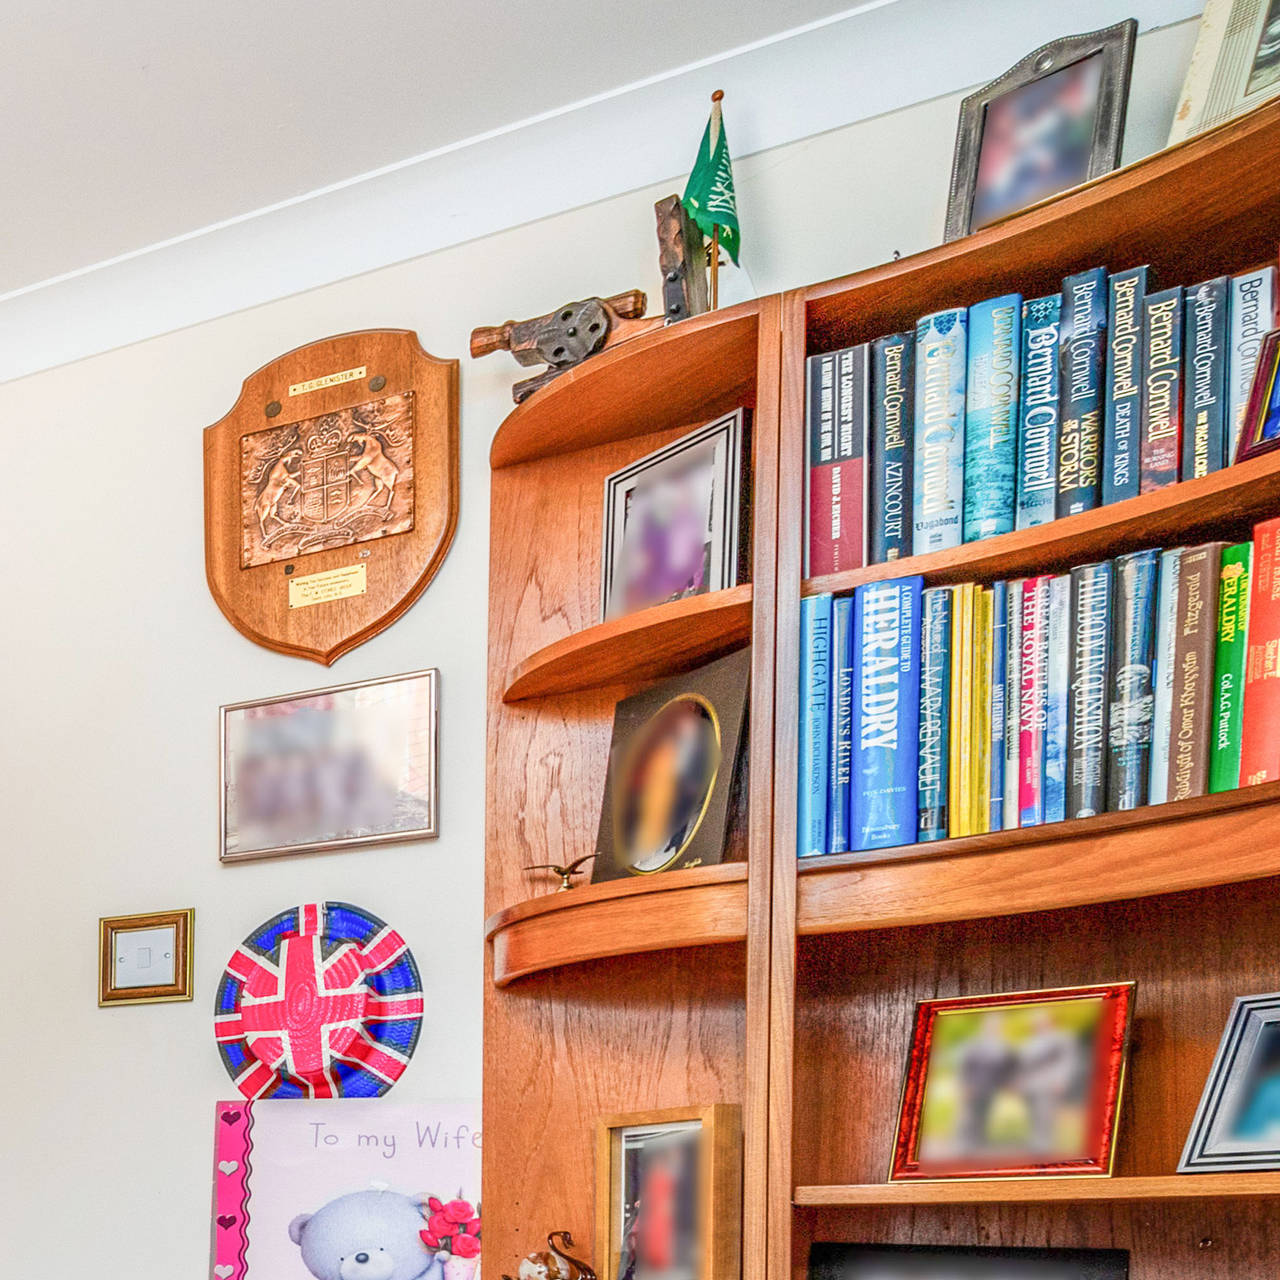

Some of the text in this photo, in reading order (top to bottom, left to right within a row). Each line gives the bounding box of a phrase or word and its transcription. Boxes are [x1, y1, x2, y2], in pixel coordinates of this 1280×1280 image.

[1114, 277, 1138, 335] Bernard
[1195, 303, 1217, 352] Bernard
[1239, 278, 1262, 339] Bernard
[885, 344, 904, 394] Bernard
[1025, 322, 1059, 406] Bernard
[1071, 281, 1097, 402] Bernard Cornwell
[1112, 335, 1138, 400] Cornwell
[1147, 299, 1179, 443] Bernard Cornwell
[841, 351, 853, 457] THE LONGEST NIGHT
[924, 341, 955, 424] Bernard
[990, 306, 1015, 450] BERNARD CORNWELL
[1193, 352, 1216, 408] Cornwell
[884, 392, 905, 450] Cornwell
[1024, 406, 1056, 492] Cornwell
[1079, 412, 1098, 487] WARRIORS
[1115, 402, 1131, 439] DEATH
[1196, 424, 1208, 454] PAGAN
[832, 467, 840, 494] DAVID
[923, 425, 955, 515] Cornwell
[1059, 432, 1079, 493] STORM
[1114, 452, 1130, 486] KINGS
[832, 505, 840, 539] EICHER
[885, 461, 902, 538] AZINCOURT
[901, 591, 912, 634] COMPLETE
[1183, 572, 1203, 636] Fitzgerald
[1221, 573, 1237, 642] ERALDRY
[861, 586, 901, 750] HERALDRY
[900, 662, 911, 672] TO
[901, 636, 912, 659] GUIDE
[1020, 587, 1037, 732] THE ROYAL NAVY
[1035, 586, 1050, 731] GREAT BATTLES OF
[1072, 573, 1108, 750] THE BODY IN QUESTION
[812, 617, 828, 795] HIGHGATE JOHN RICHARDSON
[992, 684, 1004, 702] SAINT
[1179, 708, 1194, 739] Omar
[838, 667, 852, 785] LONDON'S RIVER
[919, 666, 942, 792] MARY RENAULT
[1218, 711, 1230, 750] Puttock
[309, 1121, 483, 1159] To my Wife
